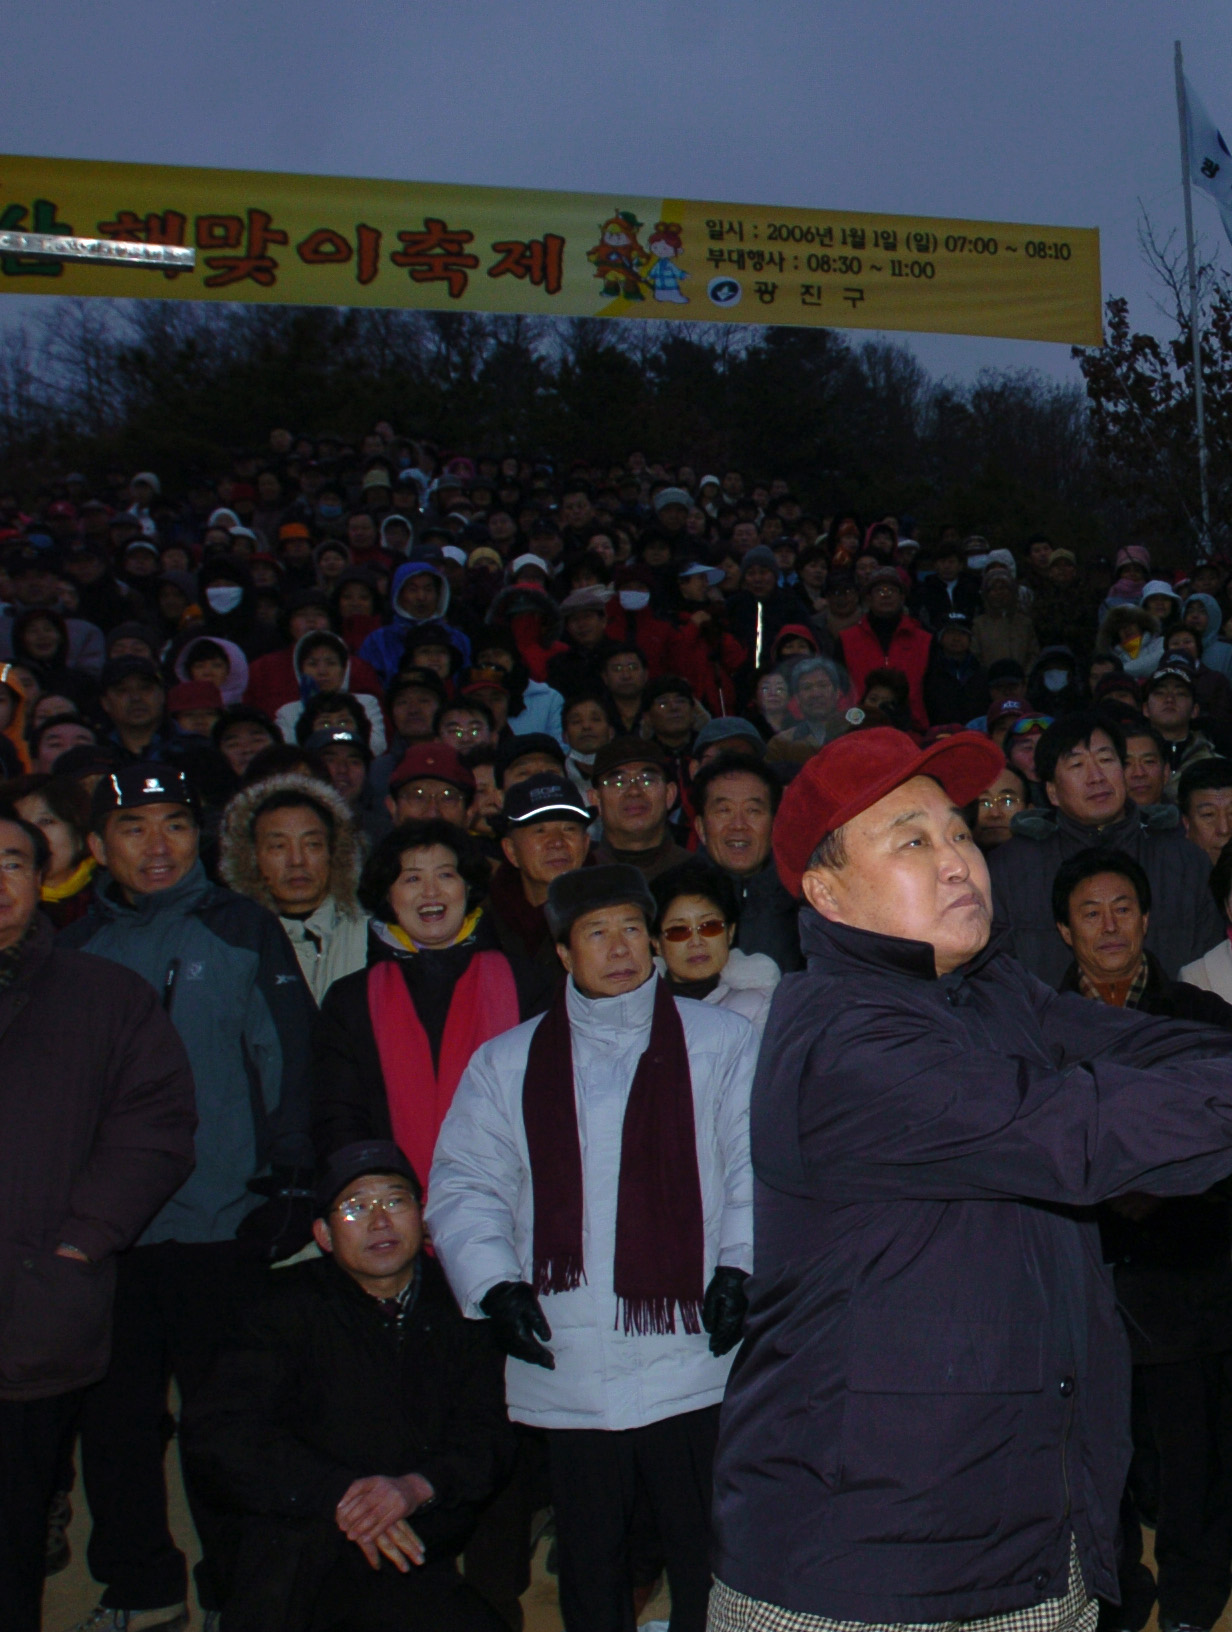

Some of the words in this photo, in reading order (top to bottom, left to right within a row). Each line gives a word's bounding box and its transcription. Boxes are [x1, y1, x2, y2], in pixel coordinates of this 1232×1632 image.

[706, 248, 786, 273] 부대행사
[806, 253, 863, 275] 08:30
[889, 259, 936, 280] 11:00
